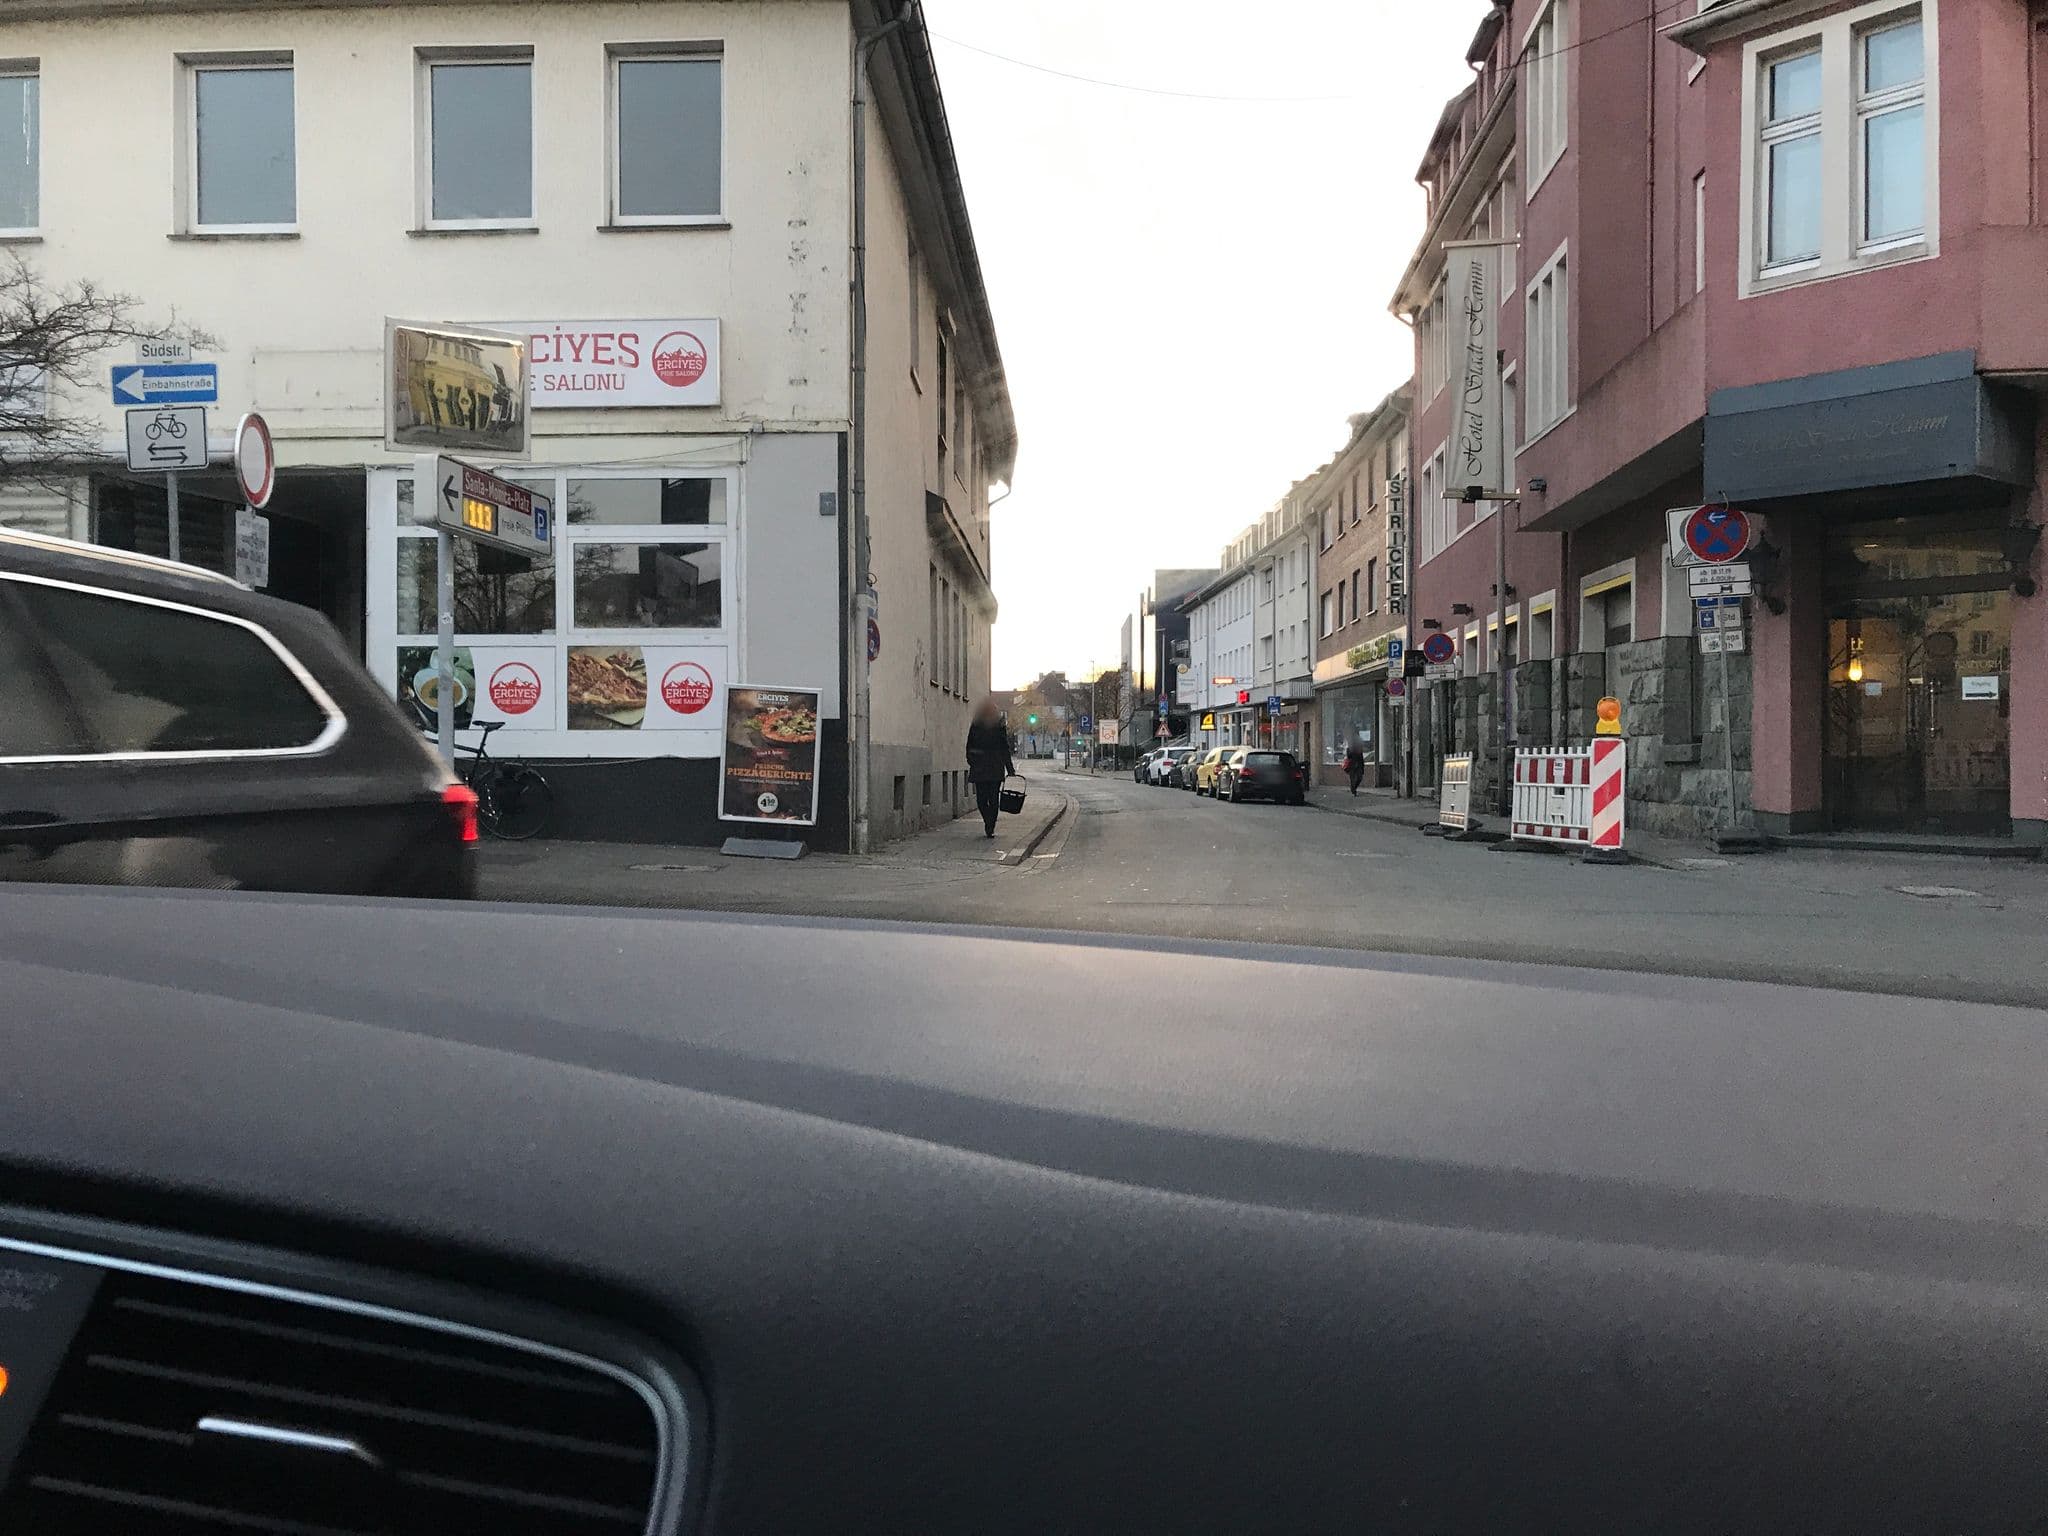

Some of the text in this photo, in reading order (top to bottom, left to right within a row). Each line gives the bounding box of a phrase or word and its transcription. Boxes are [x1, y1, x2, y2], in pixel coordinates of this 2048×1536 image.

[141, 344, 184, 357] Südstr.
[530, 326, 640, 368] CİYES
[142, 379, 212, 390] Einbahnstraße
[543, 374, 625, 391] SALONU
[1465, 344, 1483, 404] Stadt
[1461, 411, 1483, 476] Hotel
[465, 472, 530, 513] Santa-Monica-Platz
[469, 500, 492, 532] 113
[537, 513, 545, 535] P
[1390, 481, 1401, 614] STRICKER
[728, 768, 813, 780] PIZZAGERICHTE
